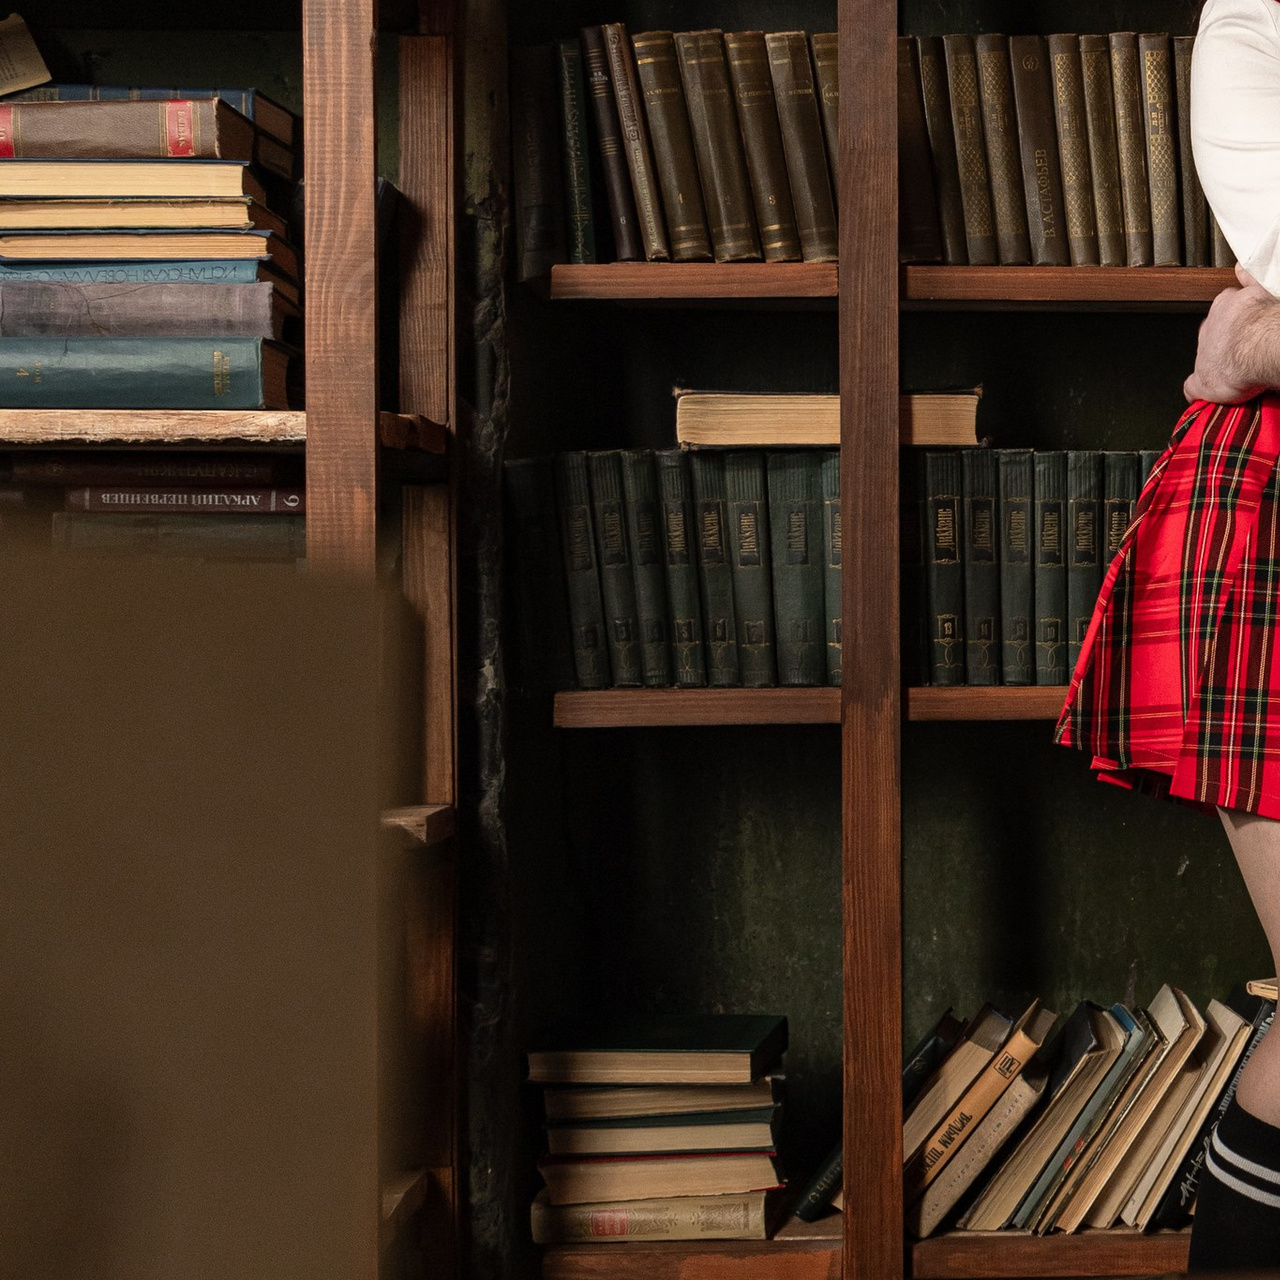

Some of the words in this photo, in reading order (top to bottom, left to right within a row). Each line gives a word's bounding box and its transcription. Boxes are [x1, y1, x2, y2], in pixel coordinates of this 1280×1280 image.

[1036, 149, 1053, 223] АСТАФЬЕВ
[143, 267, 237, 281] ИСПАНСКАЯ
[102, 493, 188, 505] ПЕРВЕНЦЕВ
[191, 495, 262, 506] АРКАДИЙ
[938, 1112, 972, 1149] ВИЛЬЯМ
